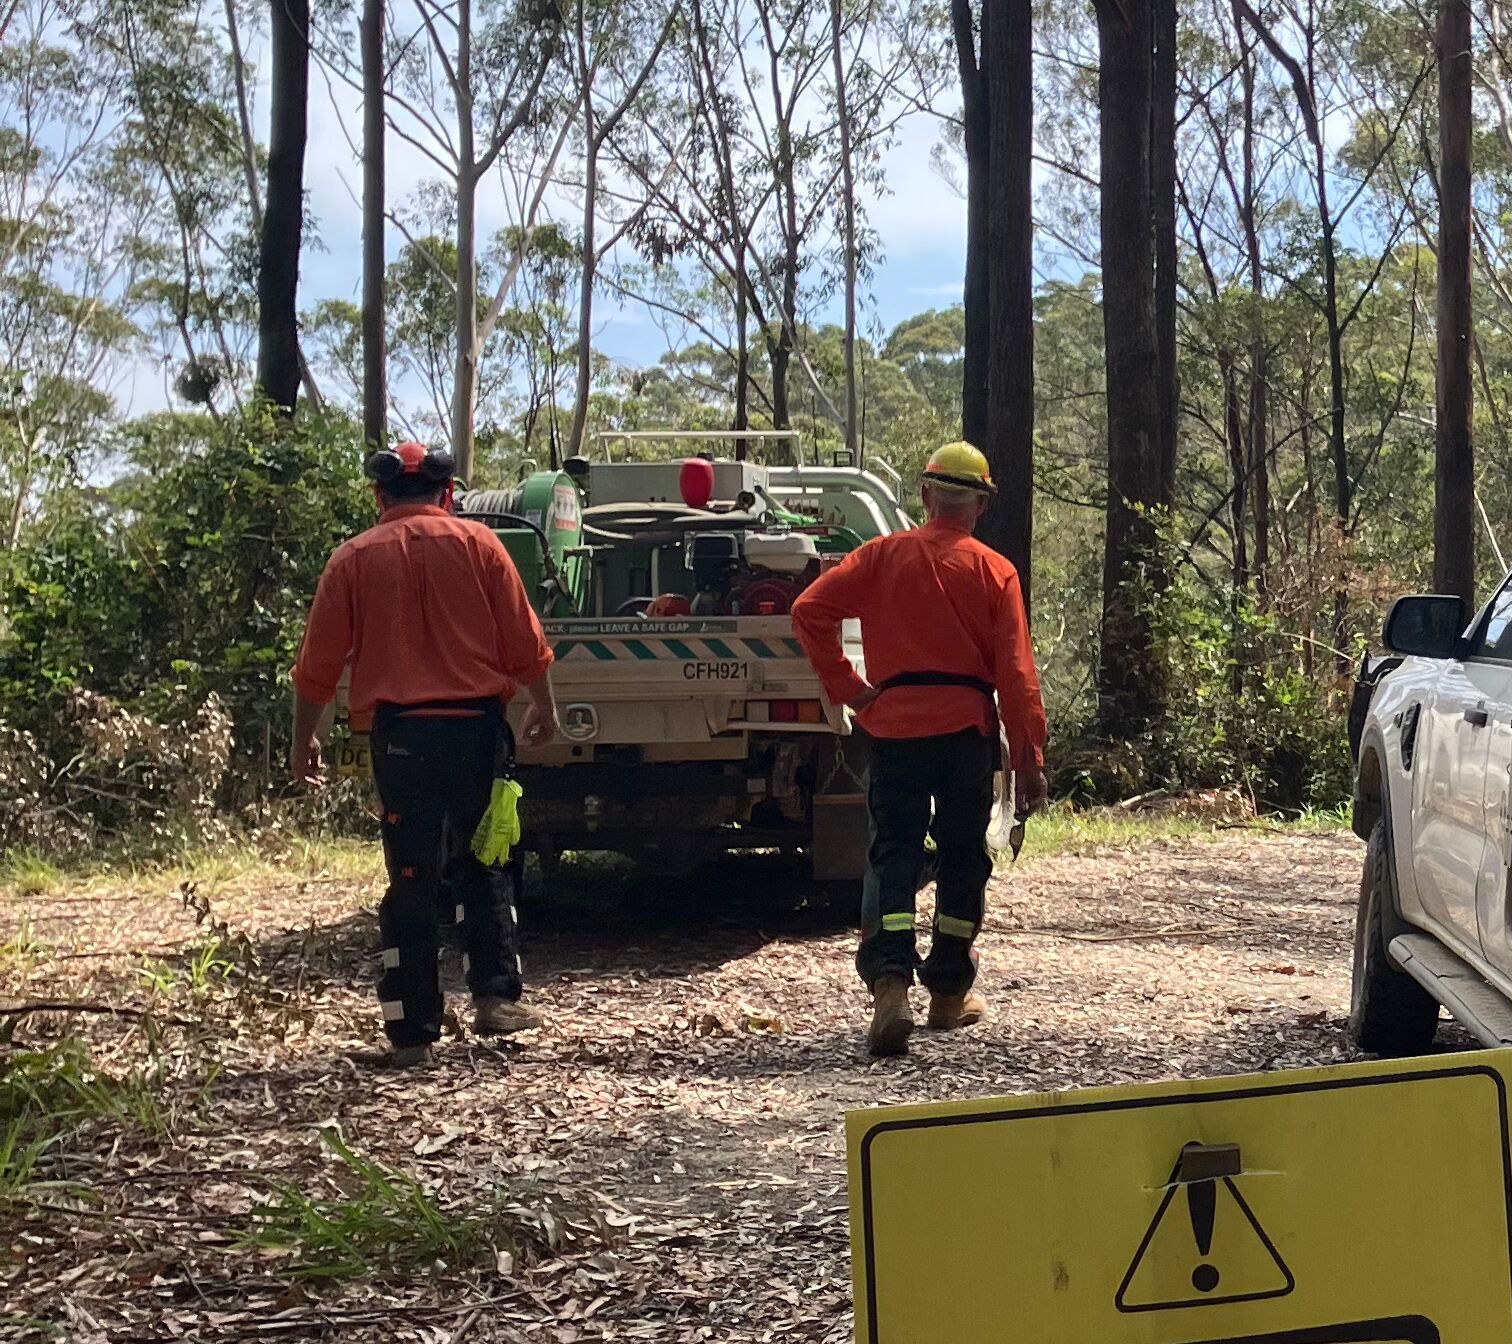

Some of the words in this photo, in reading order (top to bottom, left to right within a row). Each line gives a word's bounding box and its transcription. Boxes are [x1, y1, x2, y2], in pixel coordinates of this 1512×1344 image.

[600, 623, 630, 633] LEAVE
[631, 623, 640, 632] A
[683, 662, 748, 681] CFH921
